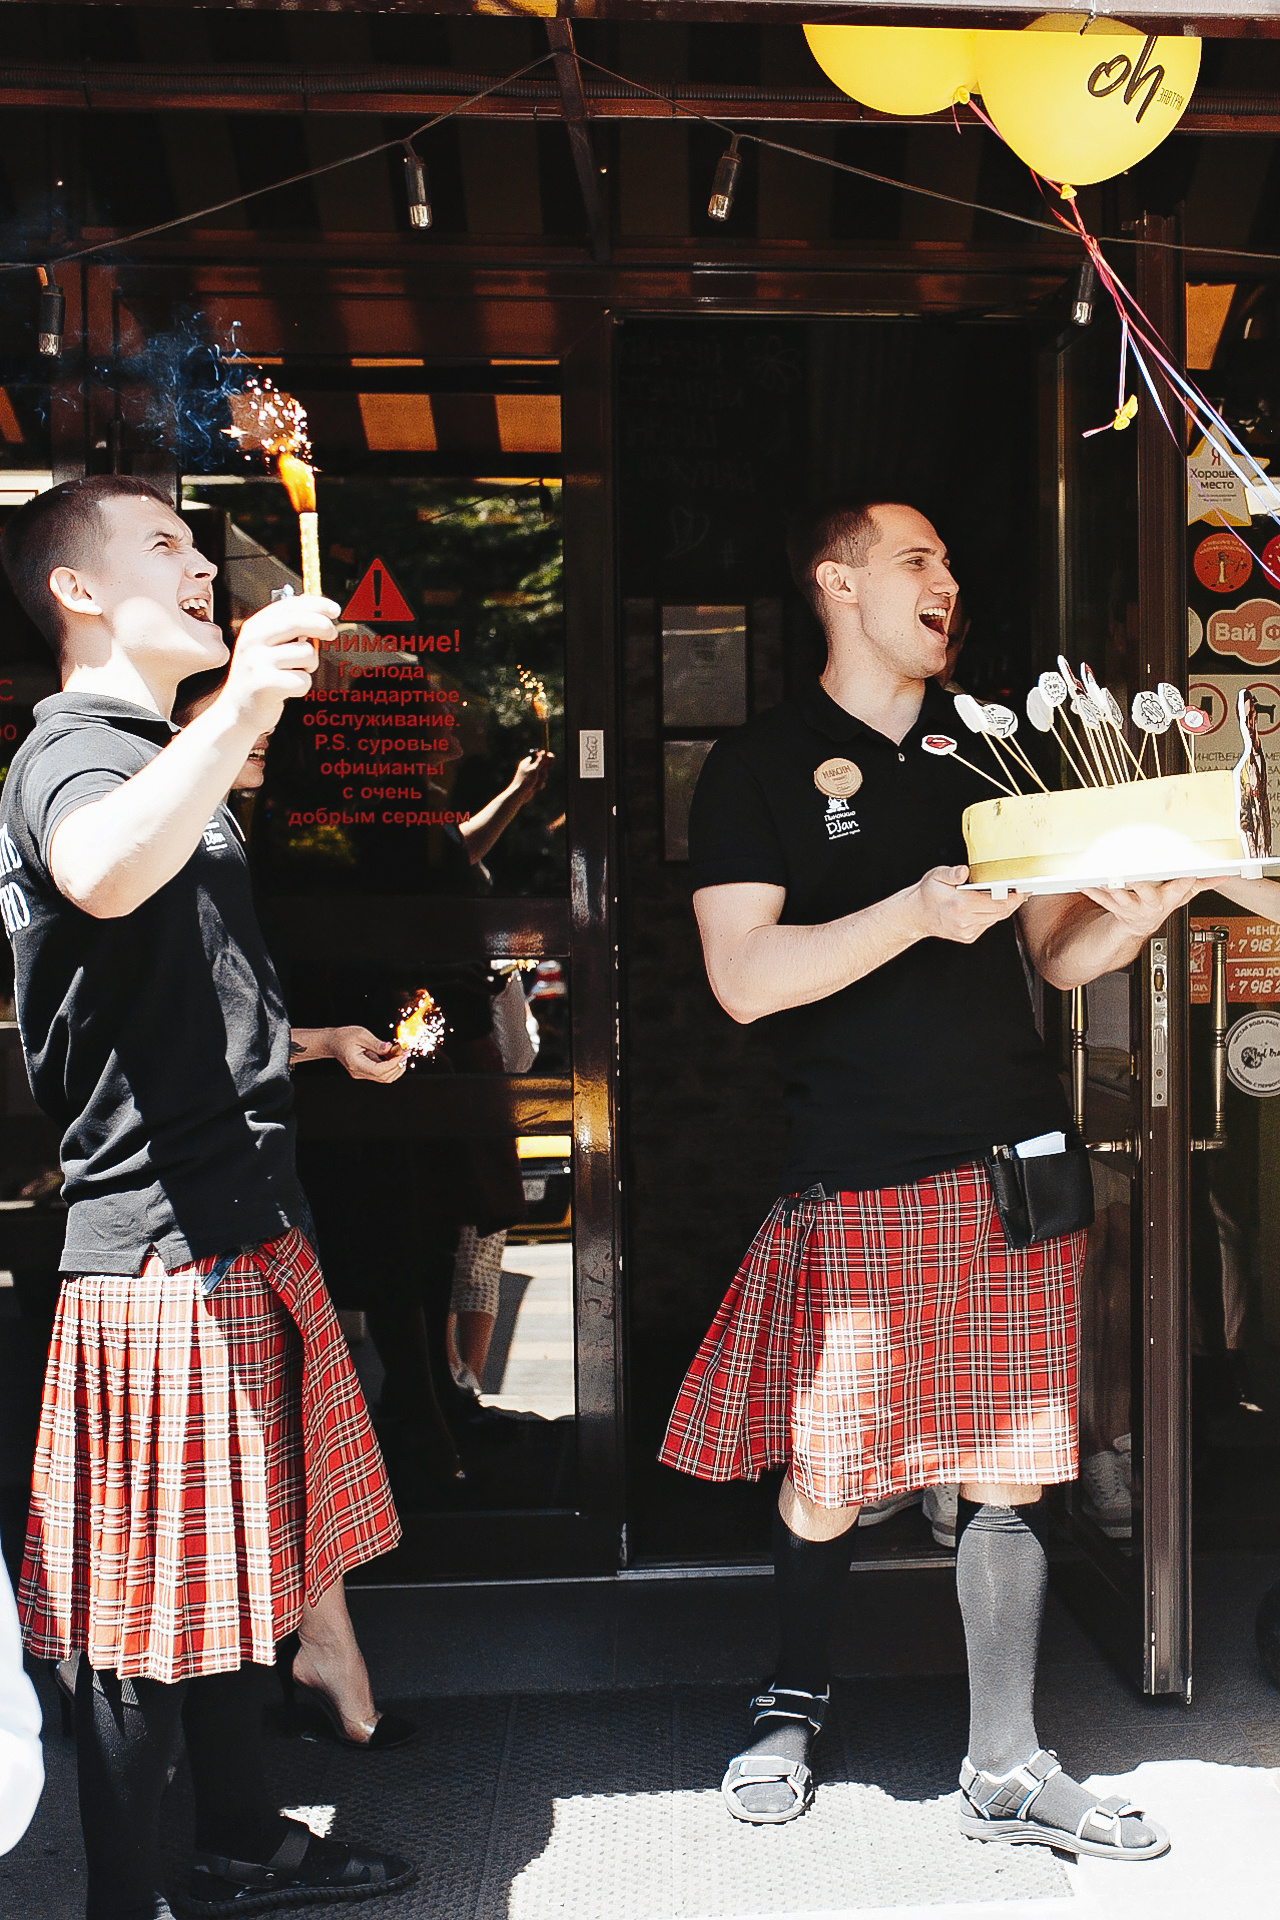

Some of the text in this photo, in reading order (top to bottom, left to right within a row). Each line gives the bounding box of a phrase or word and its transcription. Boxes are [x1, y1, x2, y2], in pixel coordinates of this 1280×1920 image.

[1087, 35, 1166, 124] oh
[1211, 447, 1221, 466] Я
[1200, 481, 1235, 490] место
[323, 629, 460, 652] нимание!
[1215, 622, 1257, 641] Вай
[338, 661, 431, 682] Господа,
[302, 709, 461, 731] обслуживание.
[314, 734, 449, 755] P.S. суровые
[320, 759, 444, 778] официанты
[342, 786, 422, 800] с очень
[288, 807, 471, 828] добрым сердцем
[1250, 938, 1273, 953] 918
[1250, 979, 1274, 994] 918
